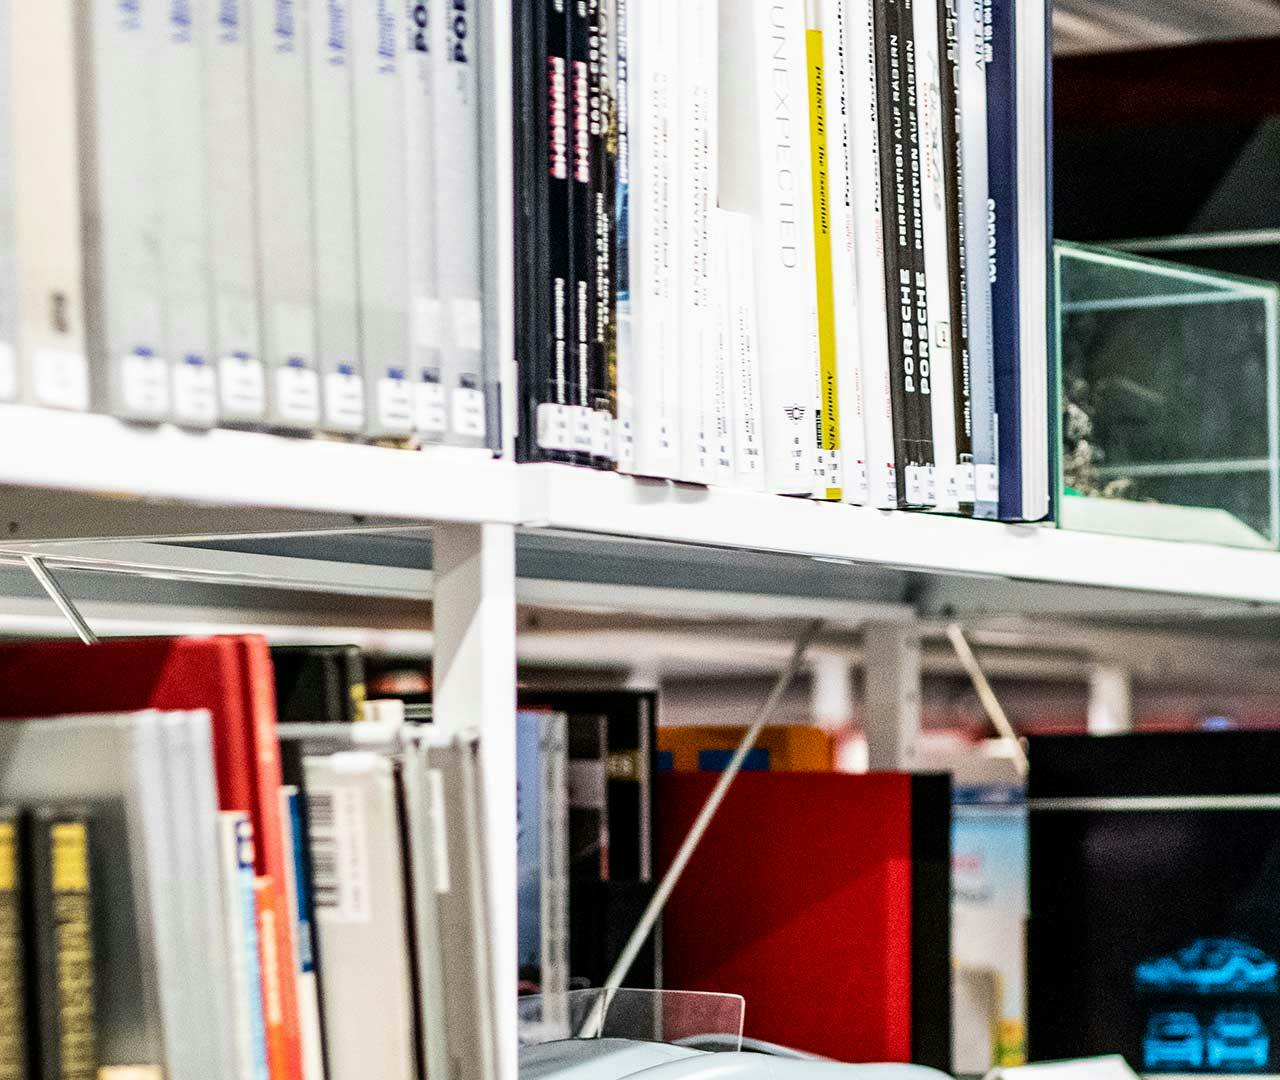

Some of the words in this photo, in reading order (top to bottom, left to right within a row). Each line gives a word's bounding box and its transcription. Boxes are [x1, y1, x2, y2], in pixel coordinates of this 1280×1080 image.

[890, 34, 902, 103] RÄDERN
[906, 40, 917, 108] RÄDERN
[770, 5, 797, 269] UNEXPECTED
[893, 106, 903, 139] AUF
[908, 112, 919, 143] AUF
[894, 143, 908, 247] PERFEKTION
[911, 147, 923, 250] PERFEKTION
[899, 268, 915, 393] PORSCHE
[915, 271, 930, 395] PORSCHE
